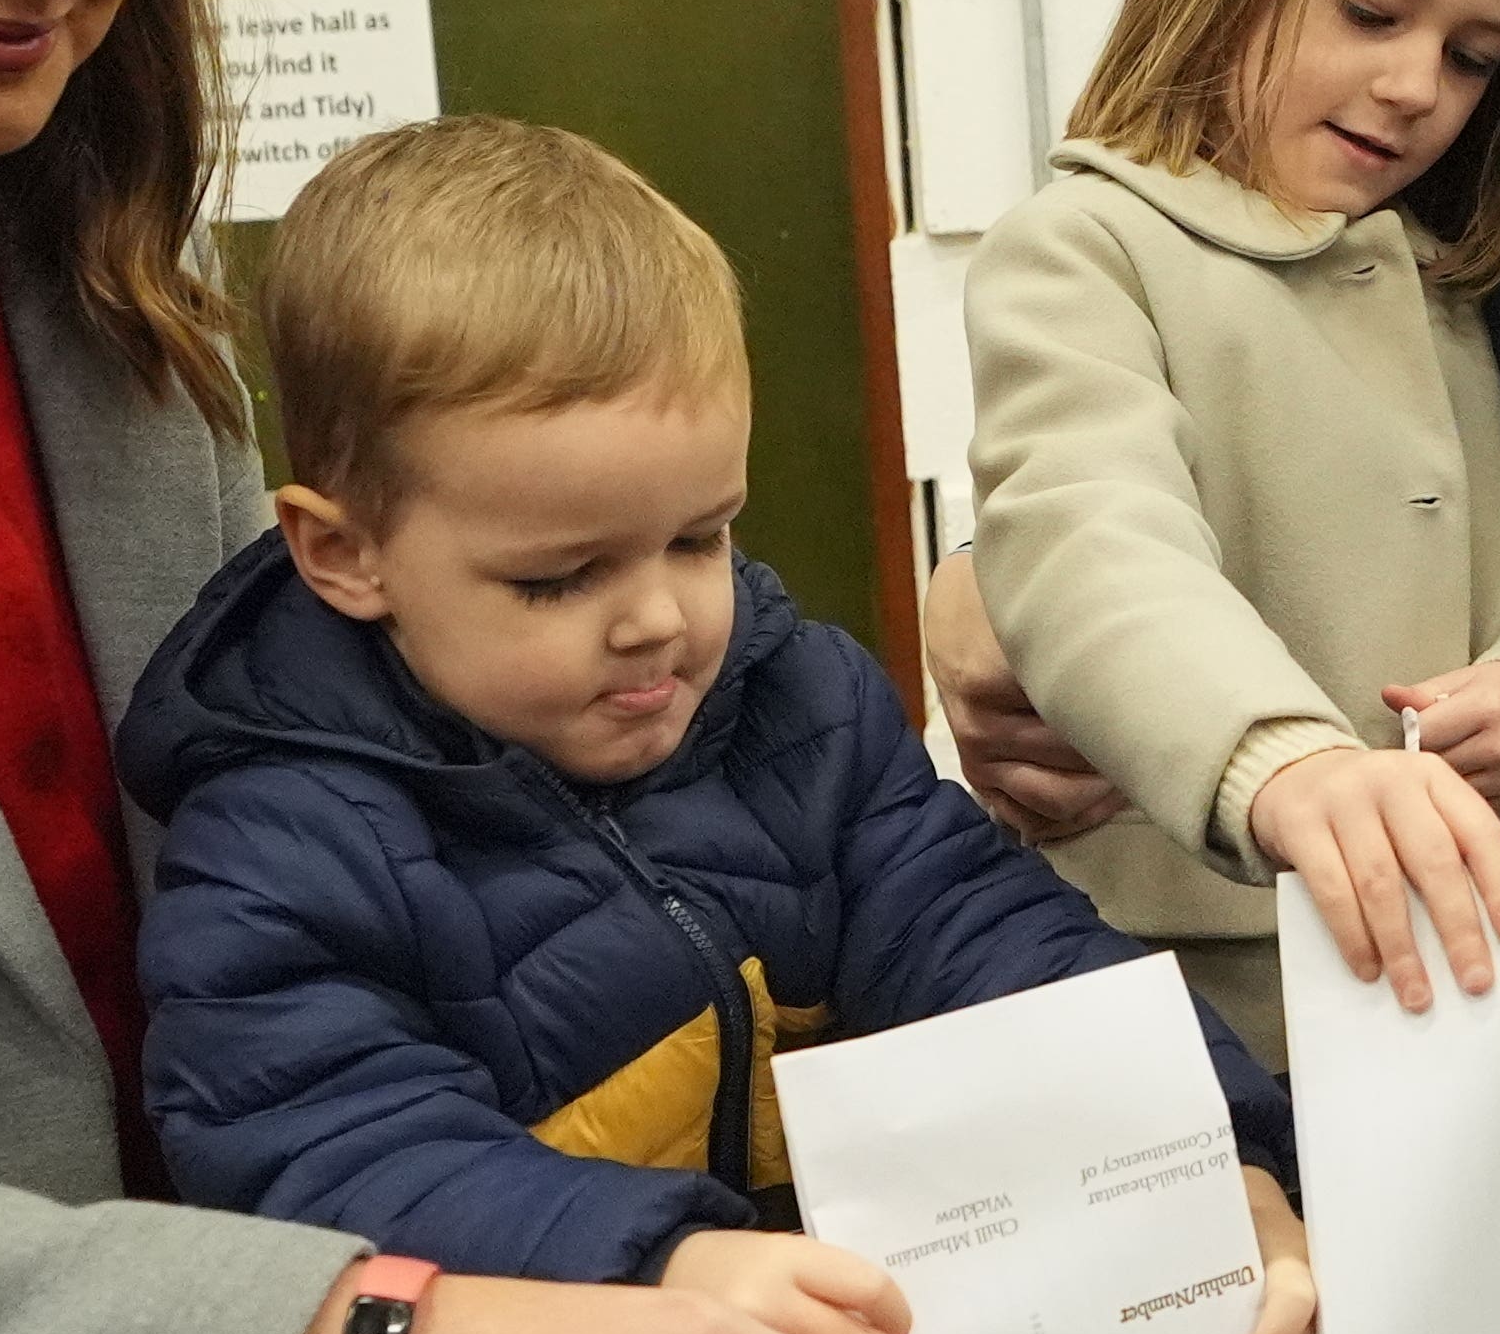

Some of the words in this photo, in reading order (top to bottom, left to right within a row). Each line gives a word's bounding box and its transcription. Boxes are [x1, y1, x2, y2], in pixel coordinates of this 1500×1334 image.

[238, 17, 304, 37] leave
[311, 9, 357, 34] hall
[365, 13, 391, 32] as
[224, 57, 257, 79] ou
[266, 51, 313, 76] find
[321, 53, 338, 73] it
[260, 96, 305, 119] and
[313, 92, 375, 118] Tidy)
[236, 138, 310, 165] witch
[1102, 1129, 1213, 1173] Constituency
[1207, 1150, 1229, 1169] do
[1078, 1163, 1099, 1187] of
[1086, 1161, 1205, 1207] Dháilcheantar
[934, 1191, 1014, 1226] Wicklow
[974, 1217, 1020, 1246] Chill
[884, 1230, 971, 1269] Mhantáin
